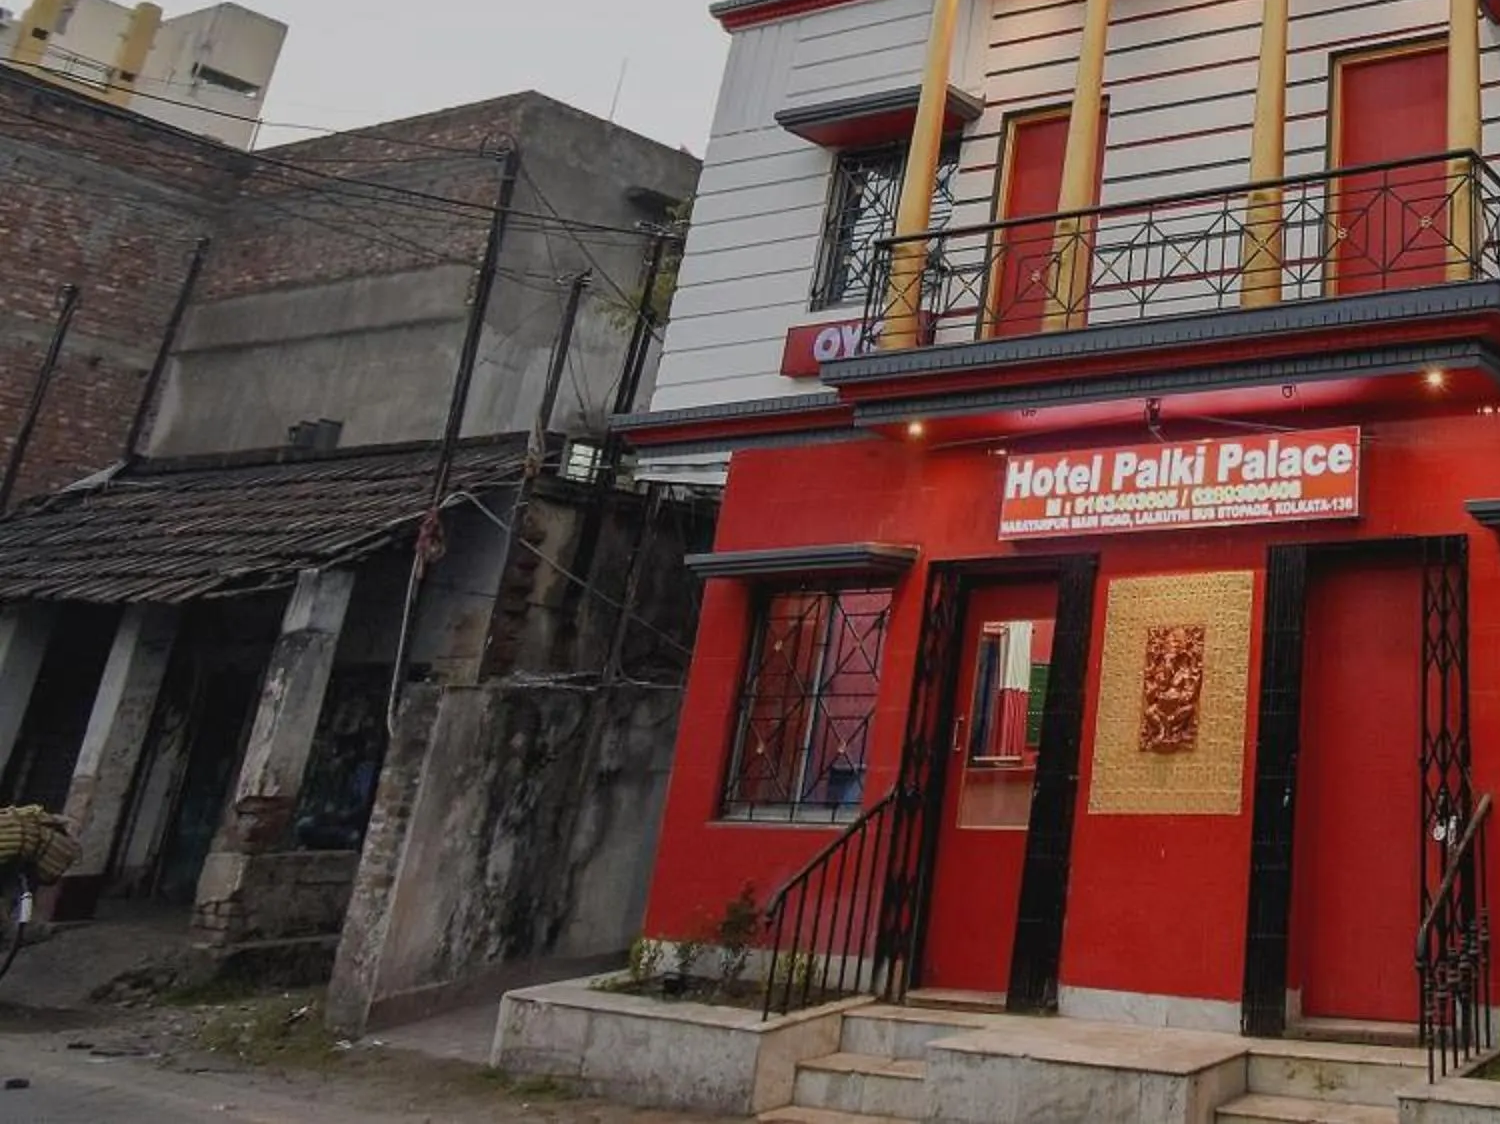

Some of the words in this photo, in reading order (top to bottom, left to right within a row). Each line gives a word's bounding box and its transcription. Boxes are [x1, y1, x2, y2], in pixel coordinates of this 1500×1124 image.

[1005, 454, 1102, 499] Hotel
[1112, 444, 1206, 491] Palki
[1217, 439, 1353, 482] Palace
